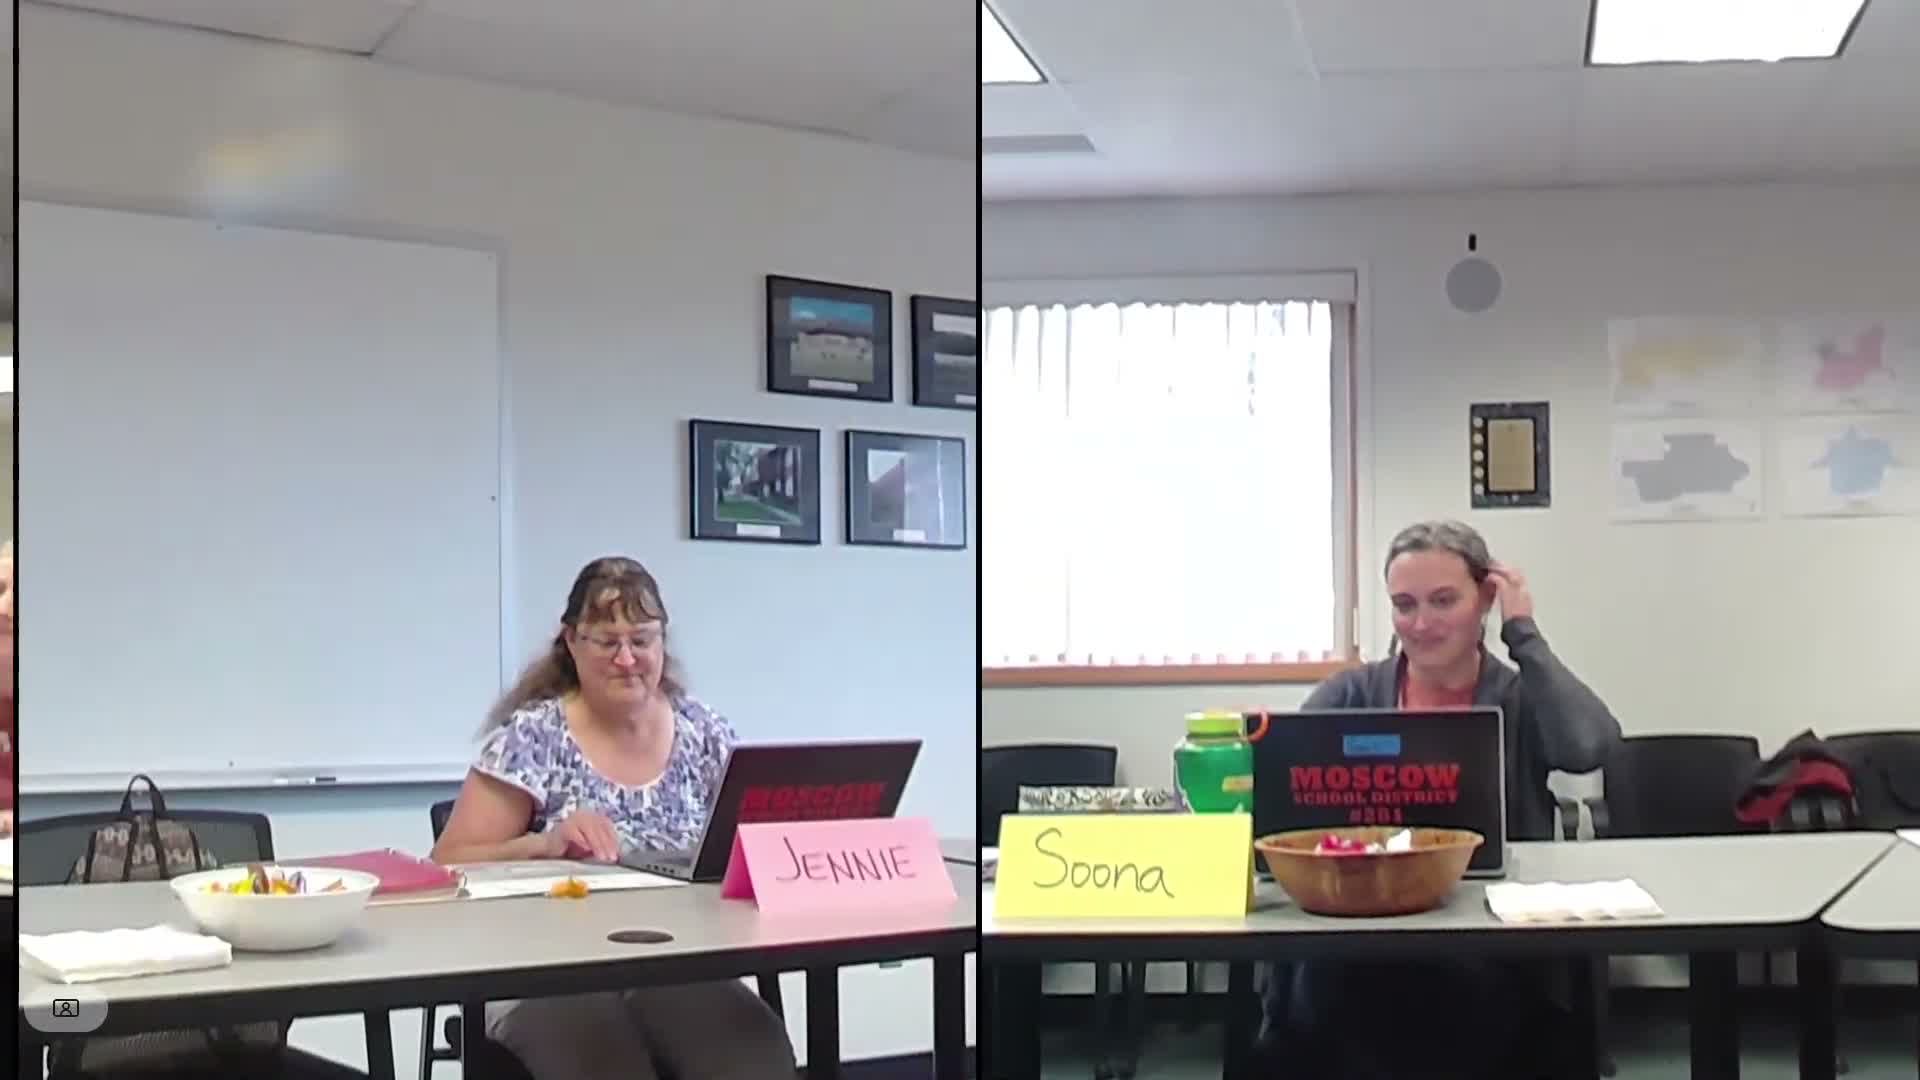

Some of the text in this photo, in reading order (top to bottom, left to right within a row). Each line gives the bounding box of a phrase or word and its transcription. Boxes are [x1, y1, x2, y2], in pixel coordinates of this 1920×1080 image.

[1290, 764, 1461, 791] MOSCOW
[1293, 790, 1458, 806] SCHOOL DISTRICT
[775, 837, 917, 884] JENNIE
[1033, 827, 1176, 899] Soona
